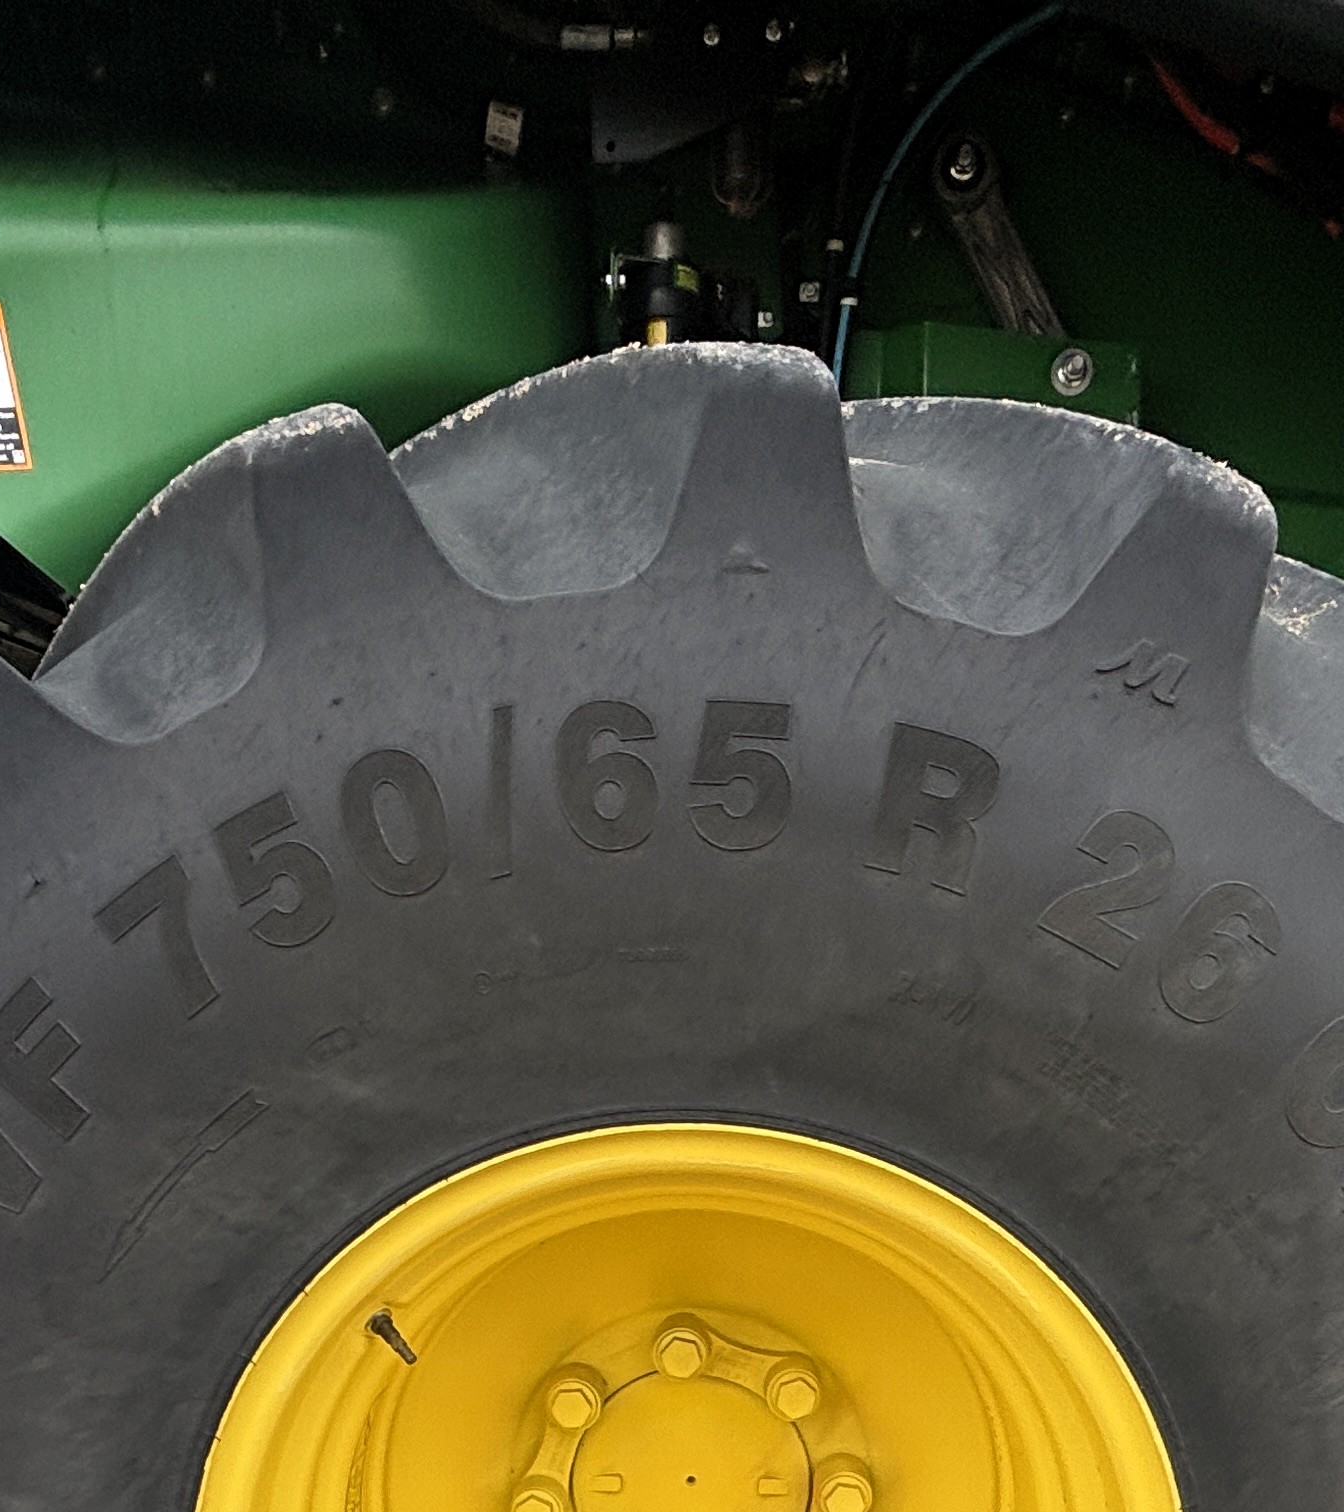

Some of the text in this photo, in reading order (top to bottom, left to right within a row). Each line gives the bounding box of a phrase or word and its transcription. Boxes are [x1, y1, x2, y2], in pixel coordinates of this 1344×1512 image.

[93, 696, 795, 1022] 750/65
[861, 719, 1005, 897] R
[1035, 808, 1285, 1026] 26
